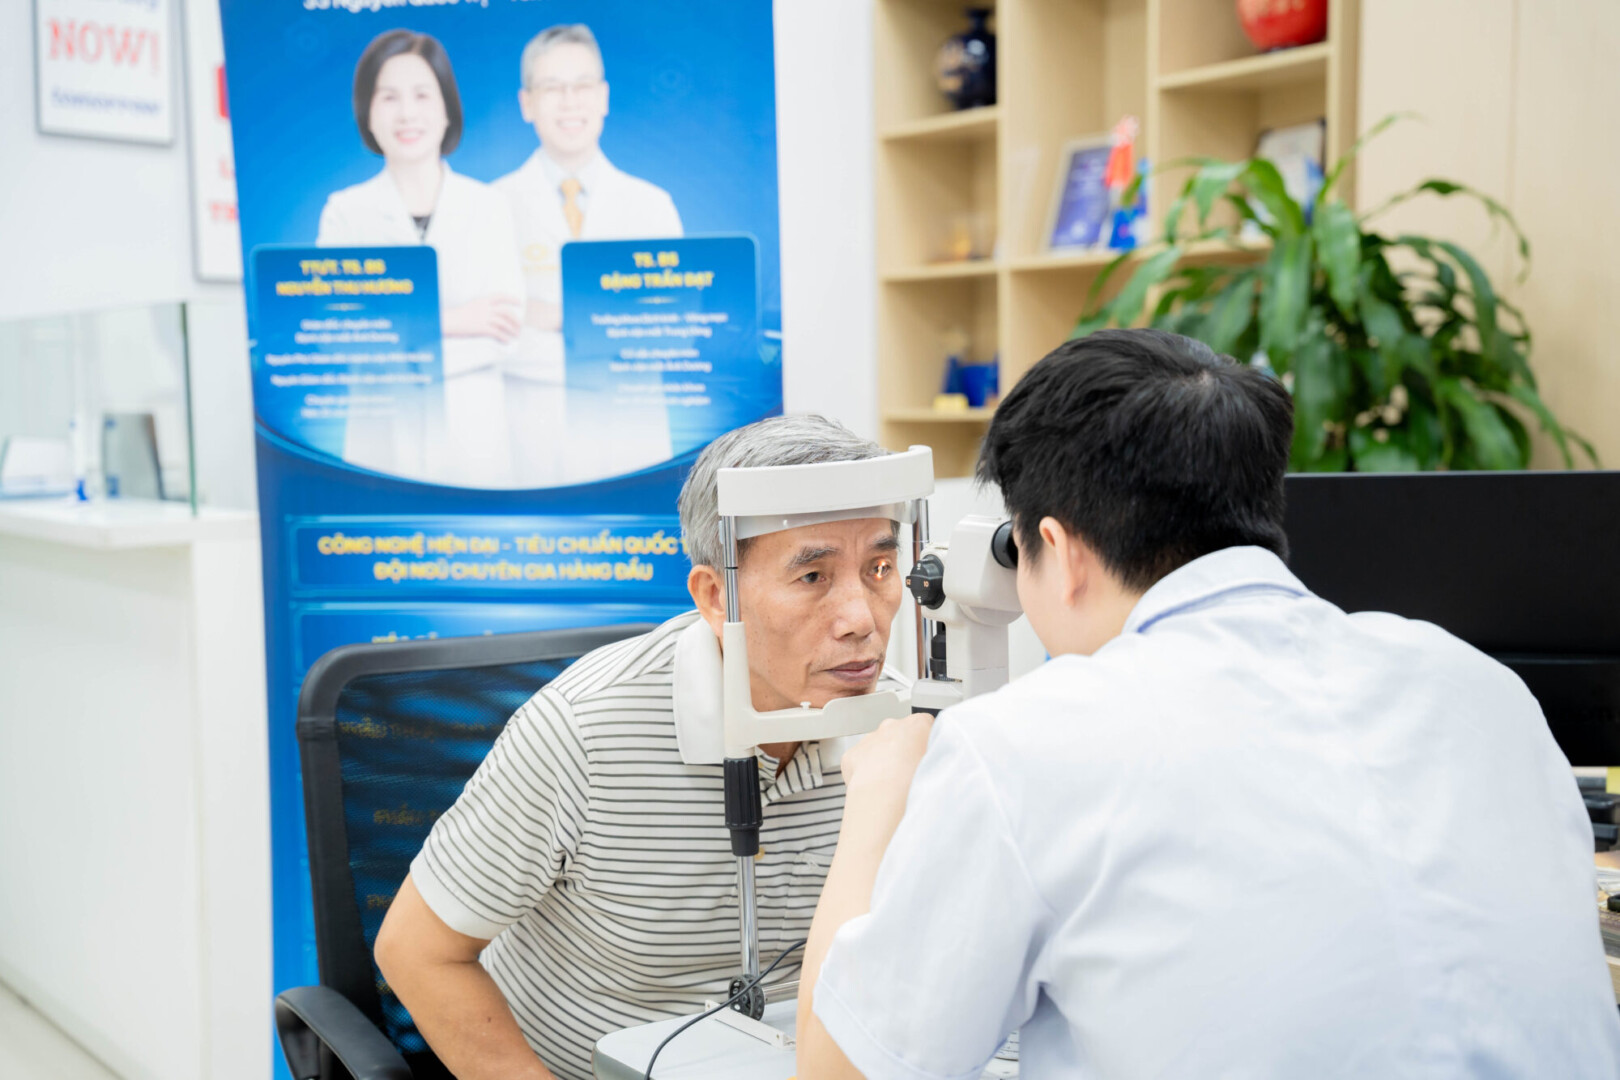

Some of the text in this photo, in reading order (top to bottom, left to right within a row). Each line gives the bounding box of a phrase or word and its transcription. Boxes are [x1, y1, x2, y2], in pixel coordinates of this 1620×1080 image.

[317, 532, 373, 555] CÔNG
[374, 531, 425, 558] NGHỆ
[624, 530, 678, 555] QUỐC
[373, 557, 408, 584] ĐỘI
[450, 559, 522, 580] CHUYÊN
[524, 562, 557, 581] GIA
